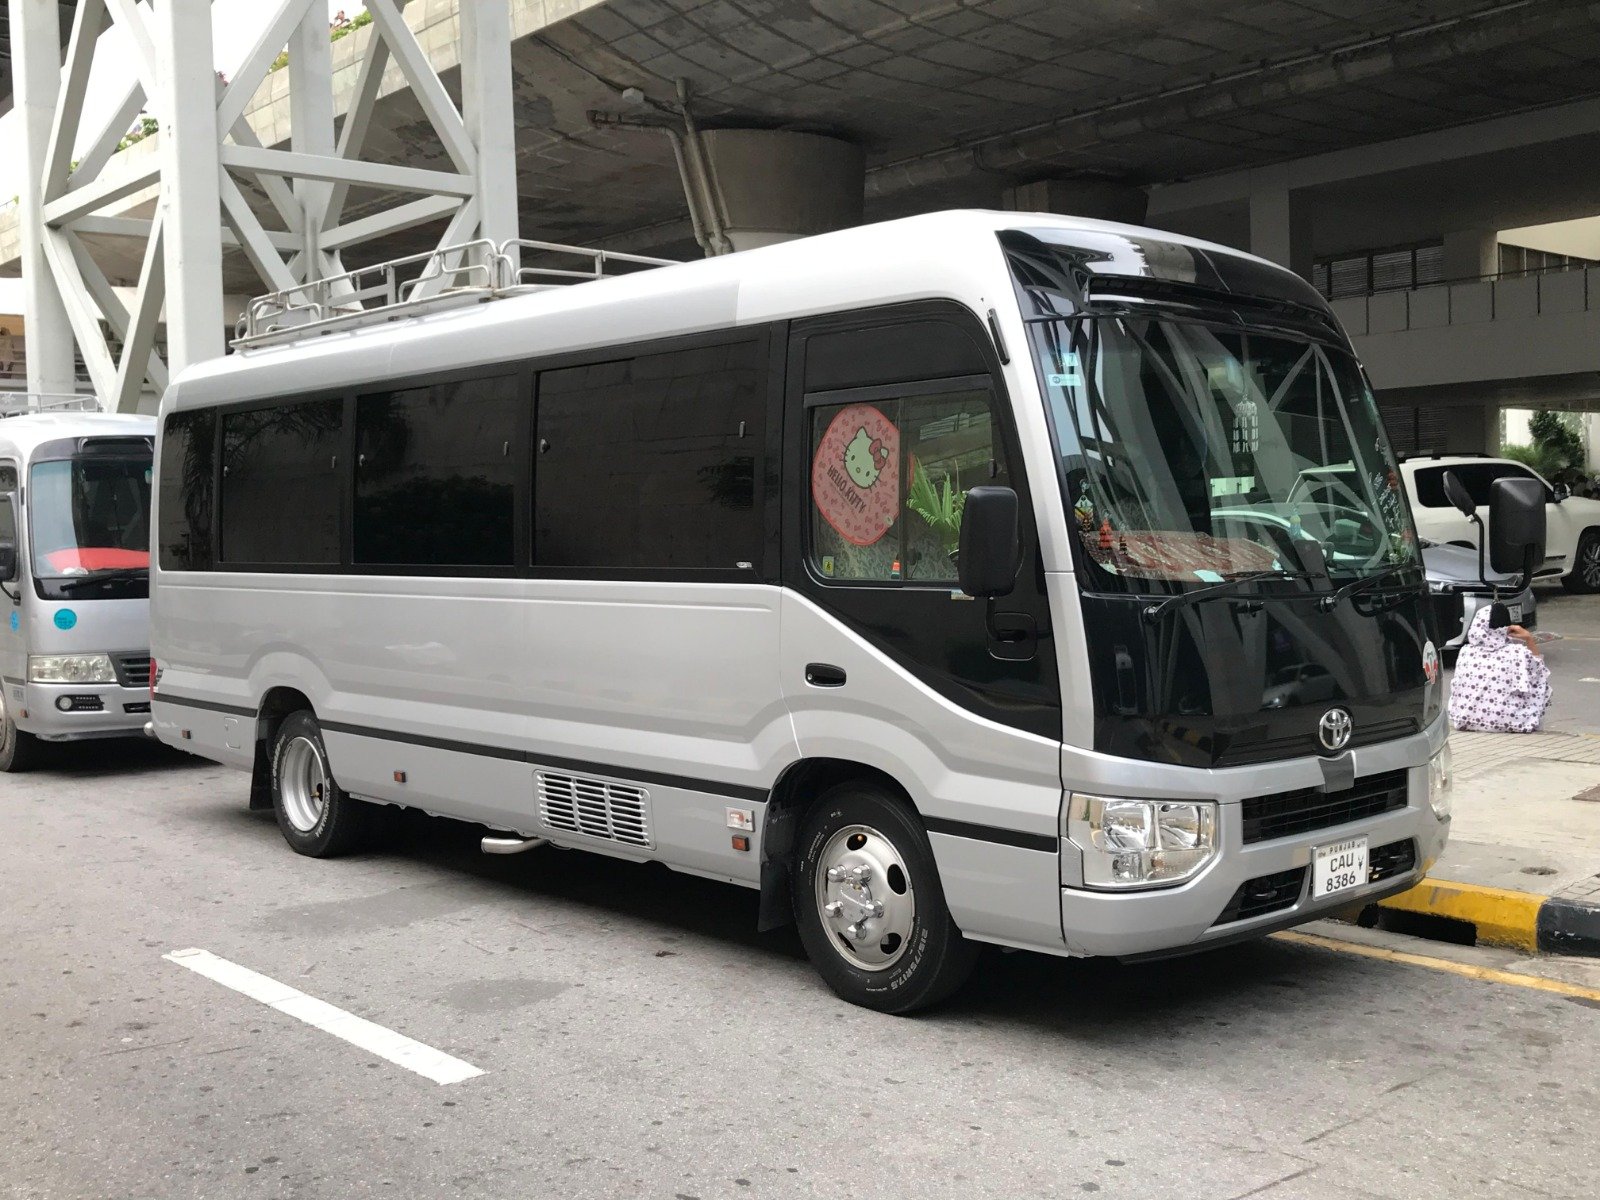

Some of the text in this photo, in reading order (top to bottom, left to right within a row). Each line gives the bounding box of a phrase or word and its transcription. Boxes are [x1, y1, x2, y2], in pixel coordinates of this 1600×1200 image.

[827, 465, 866, 513] HELLO KITTY
[1329, 840, 1355, 854] PUNJAB
[1330, 852, 1354, 873] CAU
[1326, 870, 1356, 892] 8386
